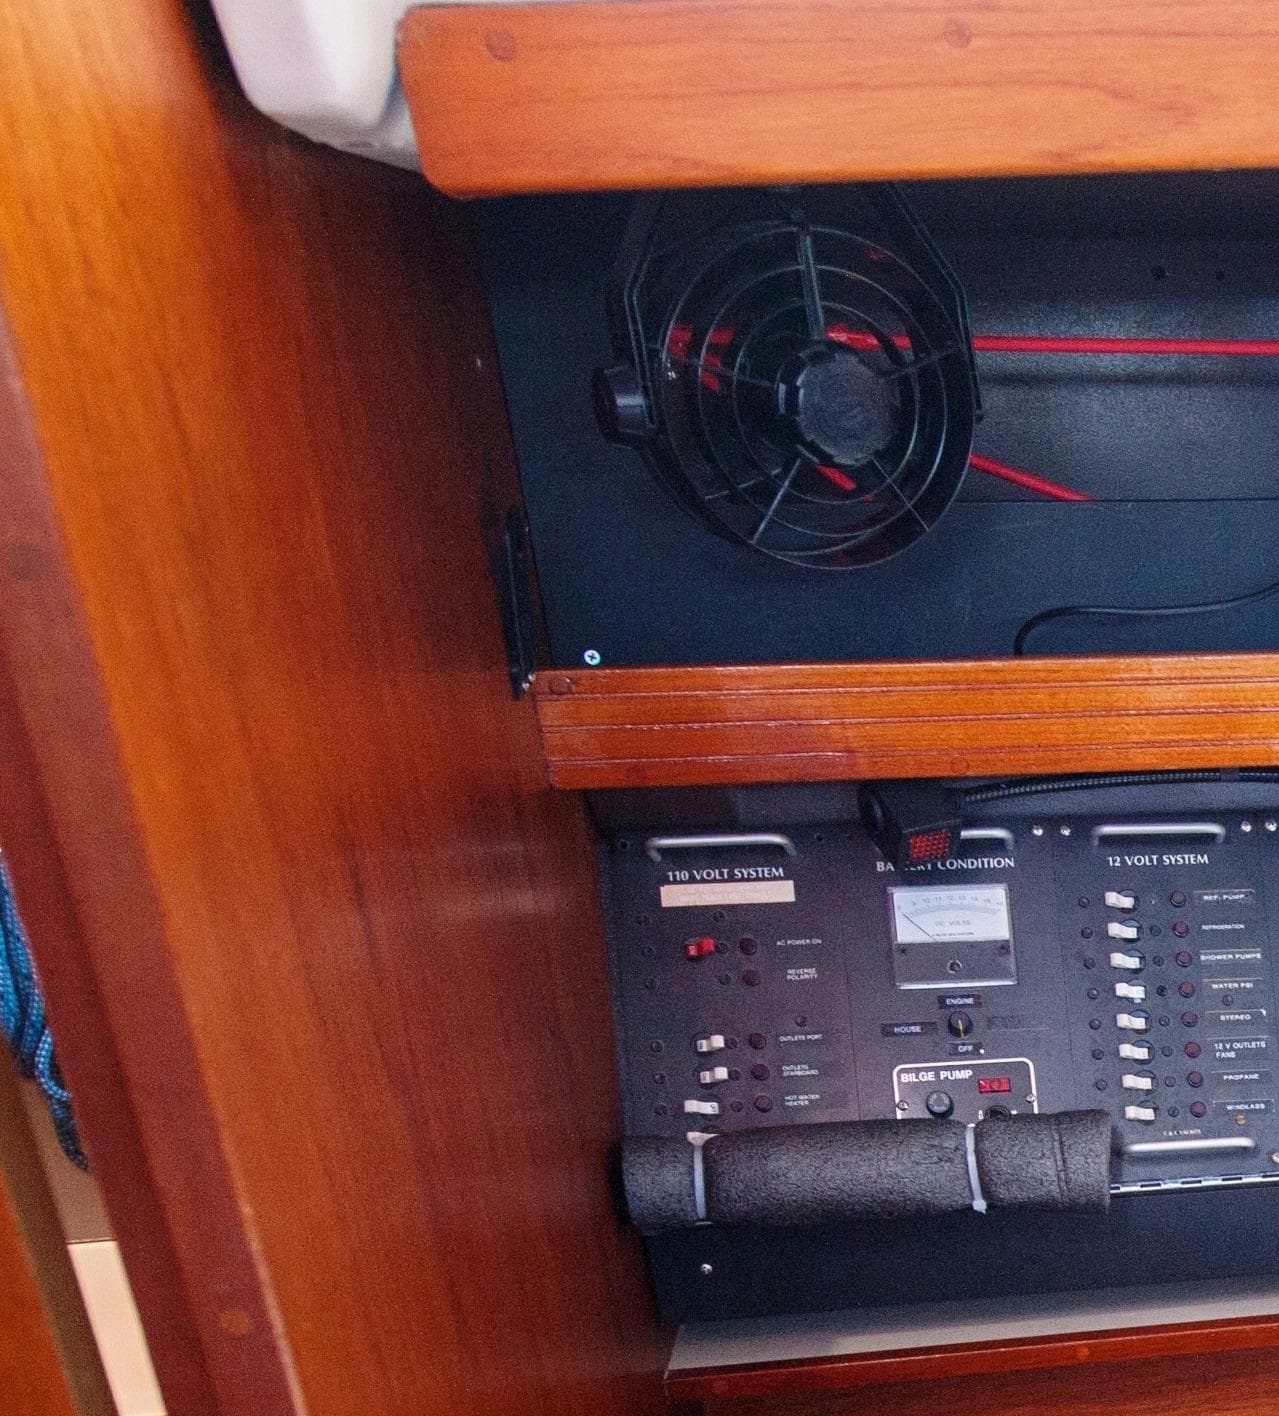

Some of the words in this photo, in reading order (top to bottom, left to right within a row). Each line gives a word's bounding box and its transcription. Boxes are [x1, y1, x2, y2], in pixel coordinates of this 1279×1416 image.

[938, 857, 1015, 870] CONDITION
[1108, 856, 1120, 866] 12
[1125, 855, 1158, 866] VOLT
[1163, 854, 1208, 865] SYSTEM
[667, 871, 689, 881] 110
[692, 868, 728, 880] VOLT
[734, 867, 784, 878] SYSTEM
[900, 1072, 935, 1083] BILGE
[940, 1070, 973, 1080] PUMP
